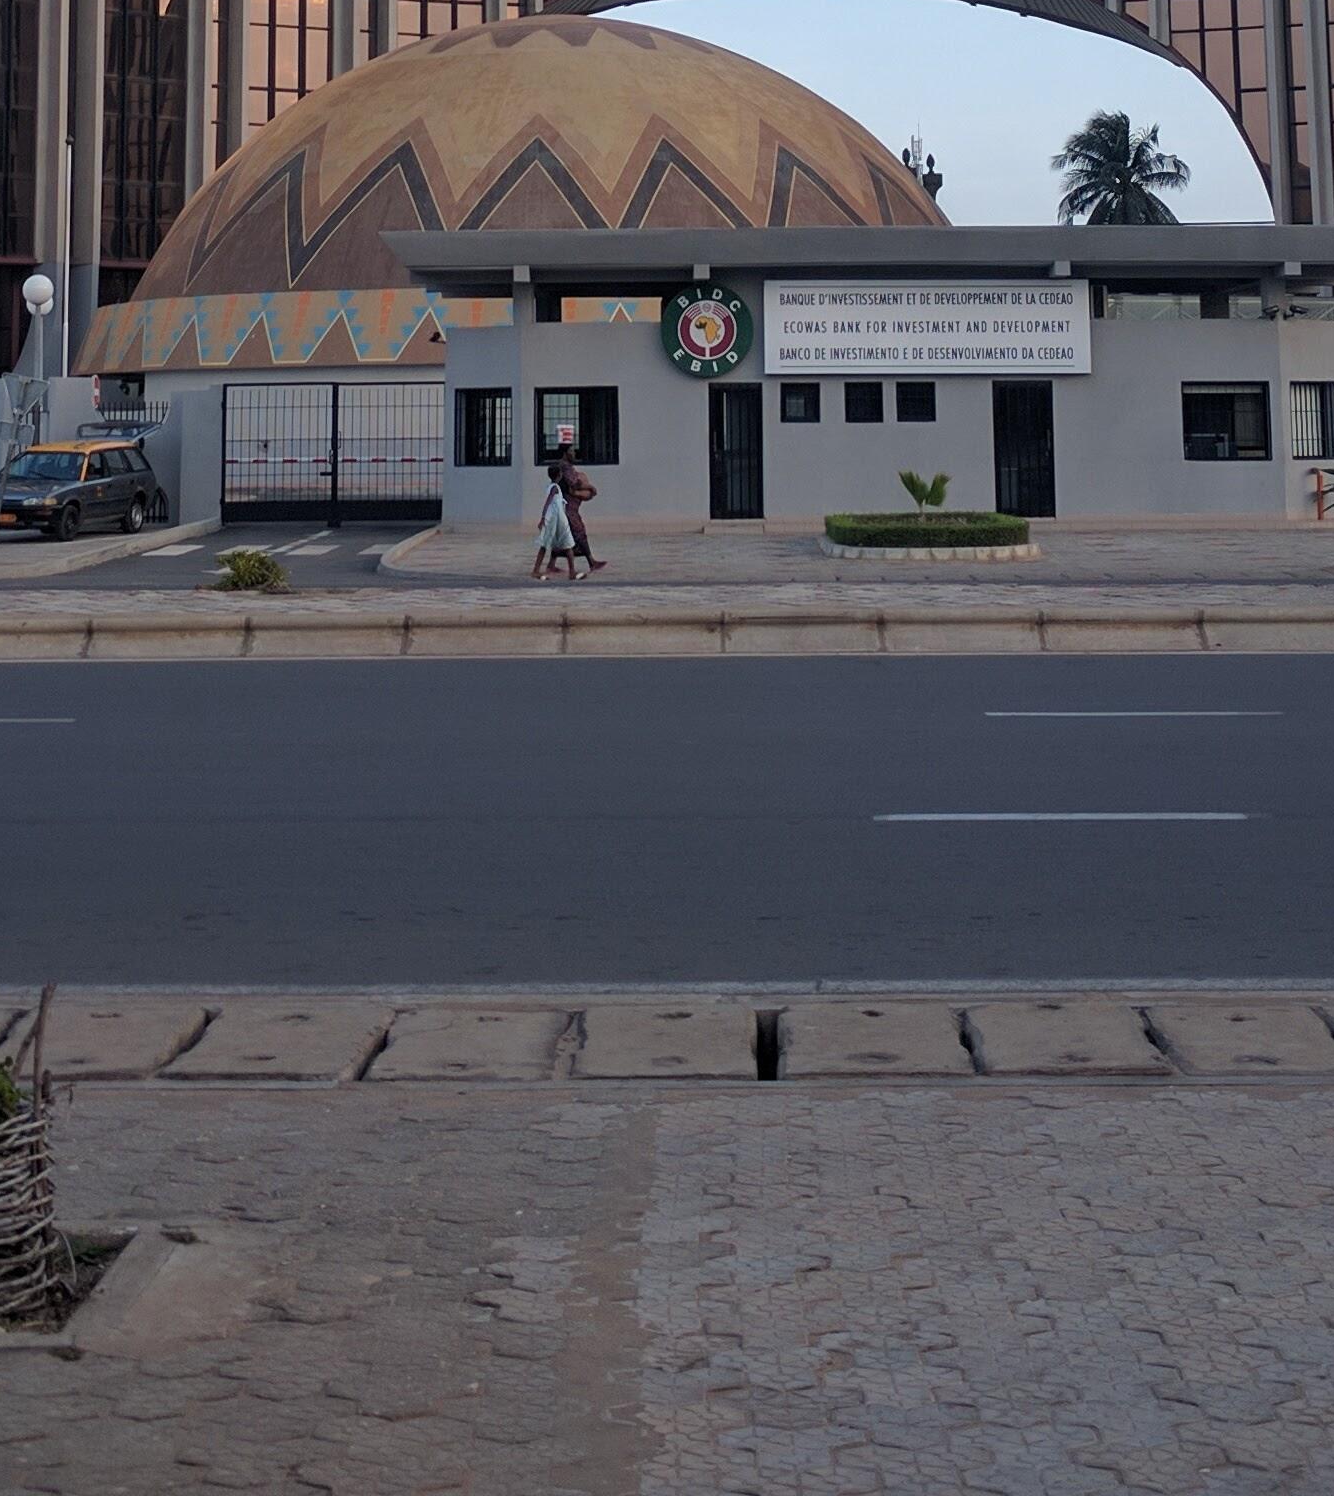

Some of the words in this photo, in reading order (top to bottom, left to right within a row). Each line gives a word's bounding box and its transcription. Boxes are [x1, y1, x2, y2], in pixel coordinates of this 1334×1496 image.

[677, 288, 741, 312] BIDC
[779, 292, 815, 306] BANQUE
[818, 292, 903, 305] D'INVESTISSEMENT
[906, 292, 917, 305] ET
[920, 292, 931, 305] DE
[934, 292, 1008, 305] DEVELOPPEMENT
[1011, 292, 1022, 305] DE
[1025, 292, 1036, 305] LA
[1038, 292, 1074, 305] CEDEAO
[783, 320, 827, 334] ECOWAS
[833, 320, 861, 334] BANK
[866, 320, 887, 334] FOR
[892, 320, 961, 333] INVESTMENT
[966, 320, 987, 333] AND
[993, 320, 1071, 333] DEVELOPMENT
[673, 348, 739, 372] EBID
[779, 347, 811, 361] BANCO
[814, 347, 826, 360] DE
[830, 347, 899, 360] INVESTIMENTO
[912, 347, 923, 360] DE
[927, 347, 1018, 360] DESENVOLVIMENTO
[1021, 347, 1035, 360] DA
[1038, 347, 1074, 360] CEDEAO
